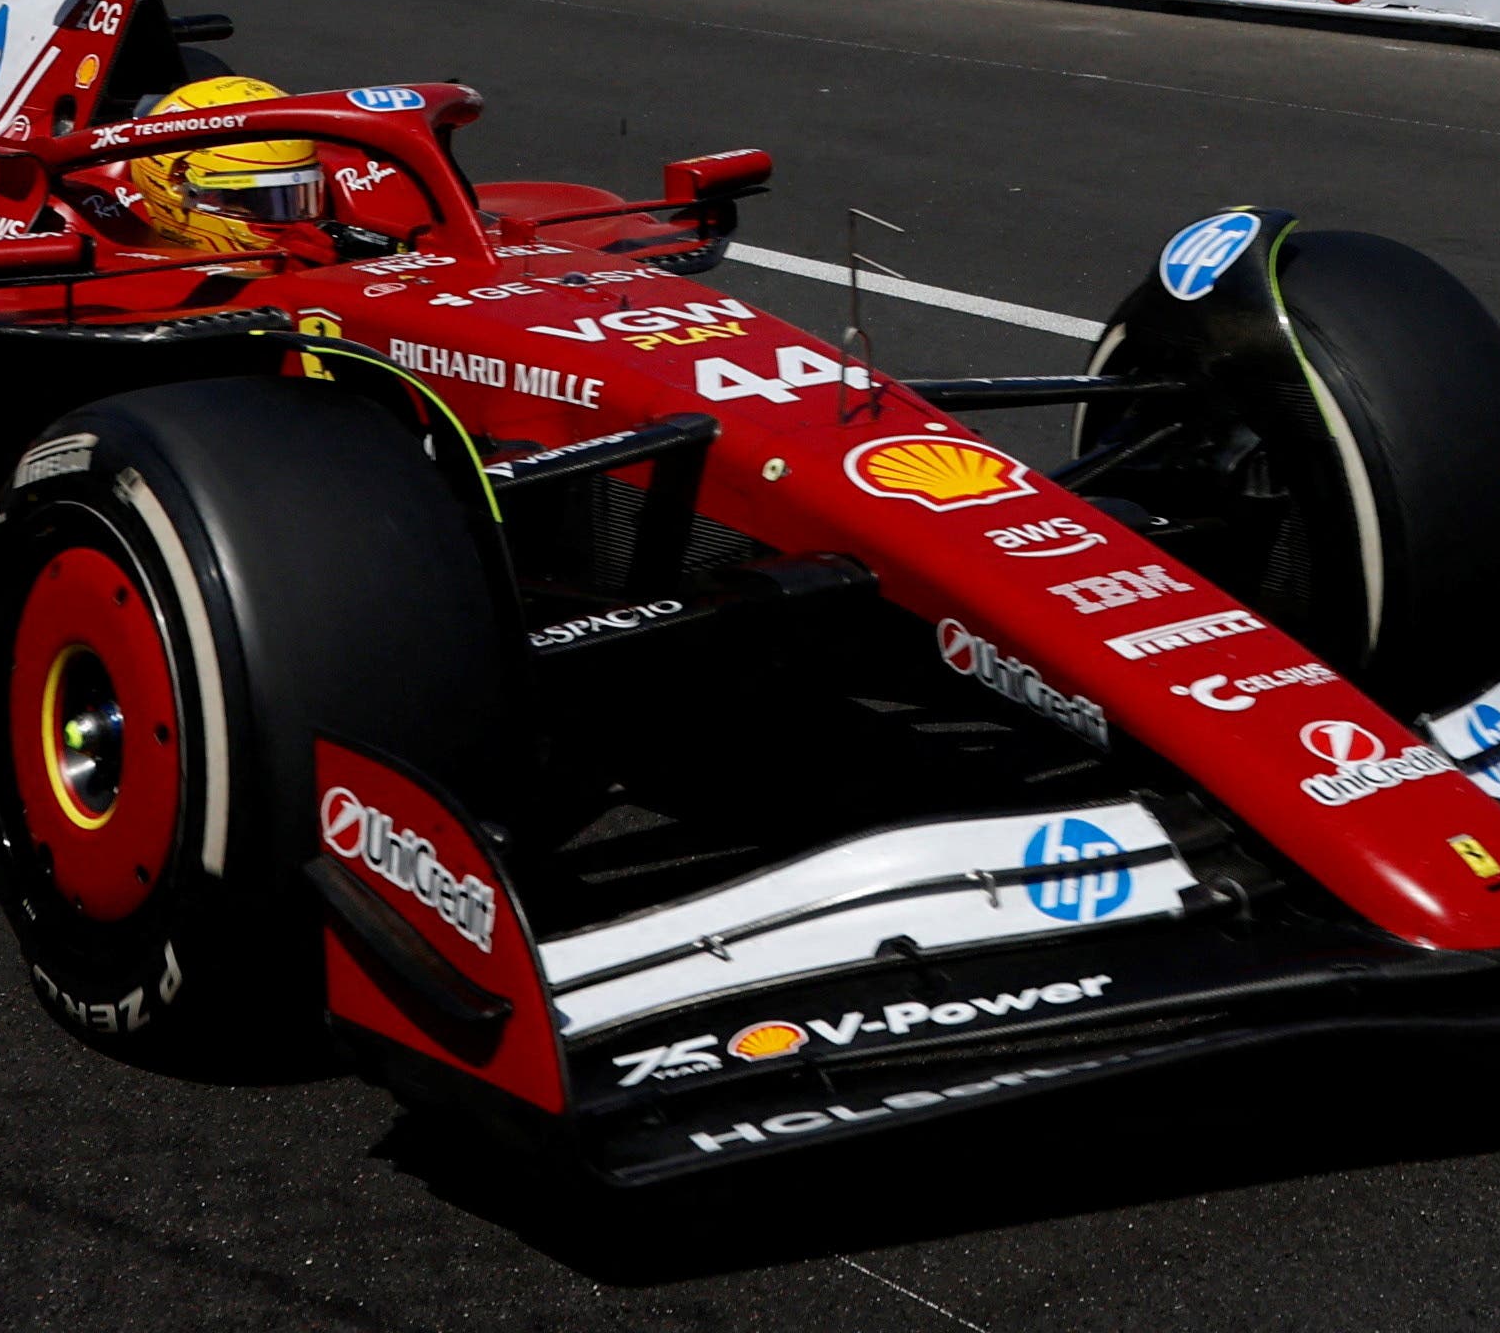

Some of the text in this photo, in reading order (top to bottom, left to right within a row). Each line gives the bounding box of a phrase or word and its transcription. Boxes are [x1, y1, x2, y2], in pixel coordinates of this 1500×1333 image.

[77, 0, 122, 35] ZCG
[349, 88, 424, 111] hp
[134, 115, 247, 136] TECHNOLOGY
[527, 298, 757, 343] VGW
[622, 322, 748, 351] PLAY
[390, 338, 604, 410] RICHARD MILLE
[695, 345, 878, 403] 44
[985, 517, 1087, 550] aws
[1047, 565, 1195, 613] IBM
[1104, 610, 1266, 660] PIRELLI
[970, 635, 1112, 749] UniCredit
[1234, 663, 1336, 692] CELSIUS
[1301, 745, 1455, 806] UniCredit
[363, 805, 495, 953] UniCredit
[1023, 817, 1132, 921] hp
[613, 974, 1113, 1087] 75 V-Power
[651, 1059, 722, 1081] YEARS
